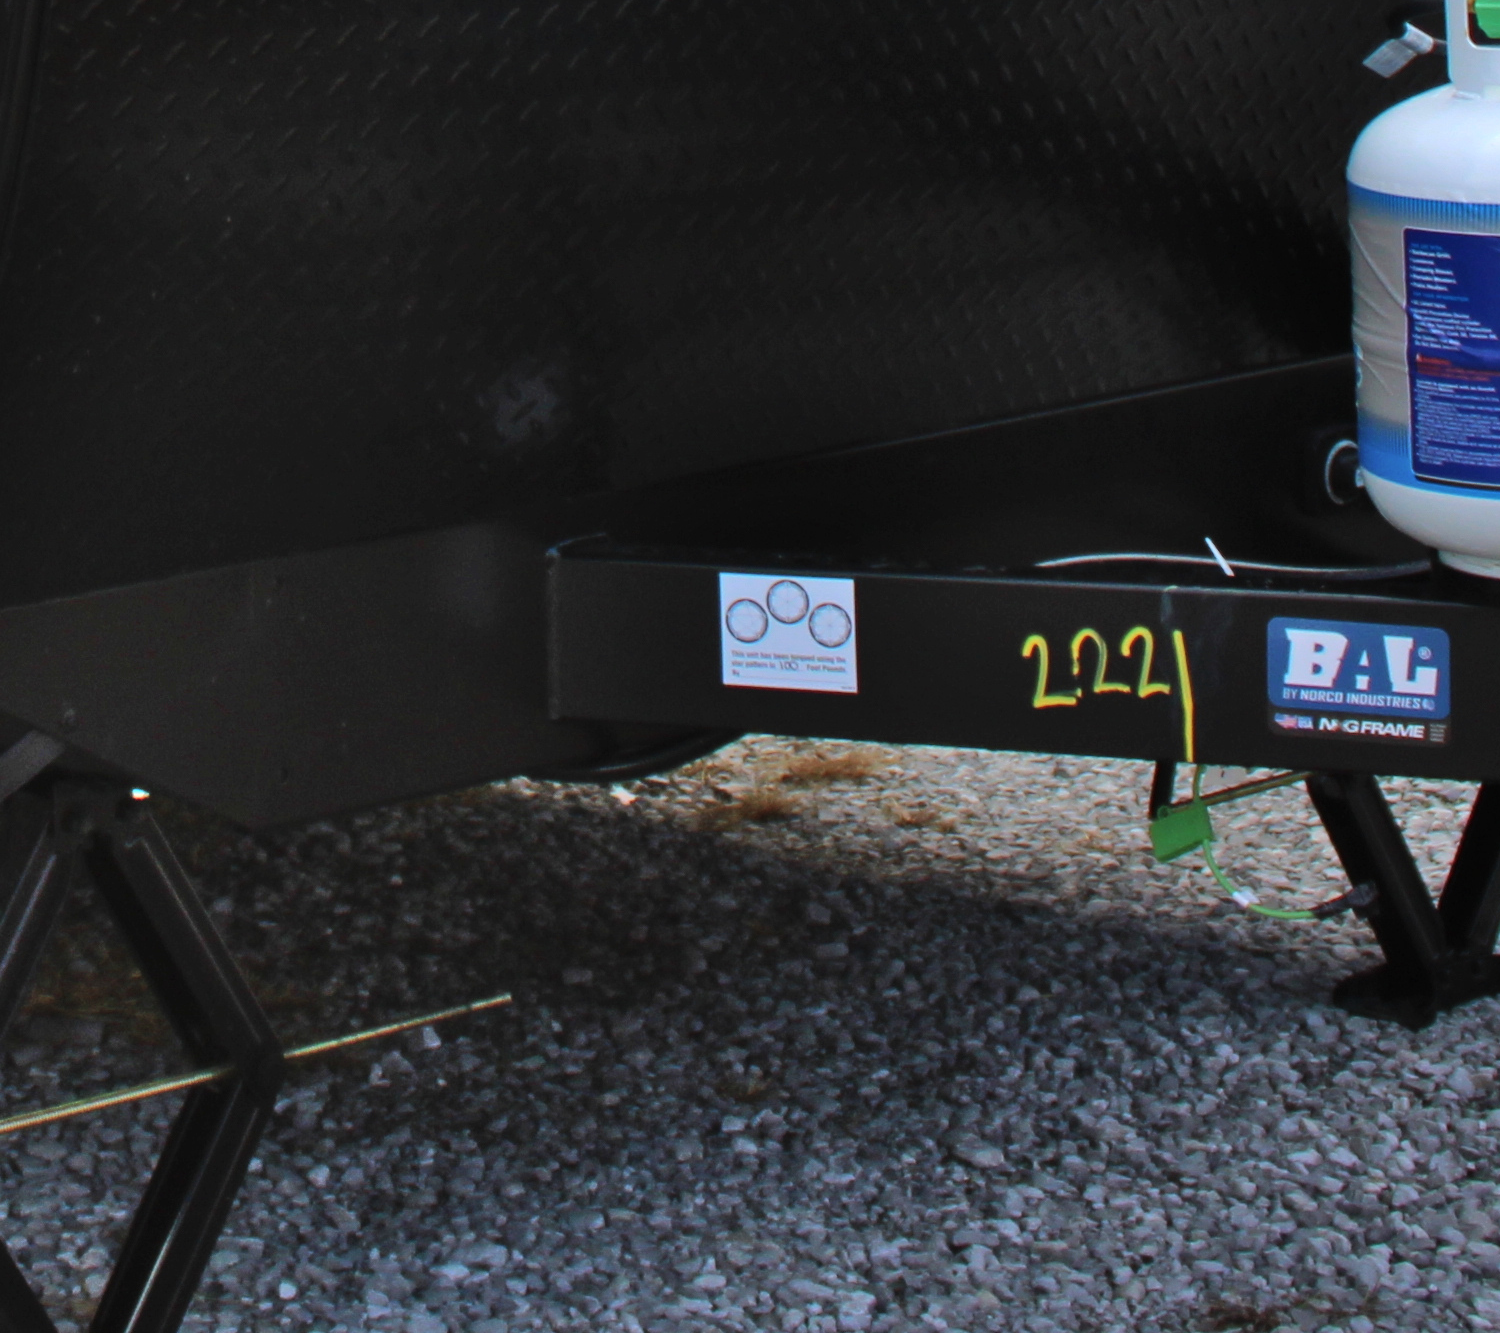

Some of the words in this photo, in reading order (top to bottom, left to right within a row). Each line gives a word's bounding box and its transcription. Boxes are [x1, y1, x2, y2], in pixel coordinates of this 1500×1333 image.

[1283, 688, 1298, 699] BY
[1300, 688, 1343, 704] NORCO
[1346, 693, 1421, 709] INDUSTRIES
